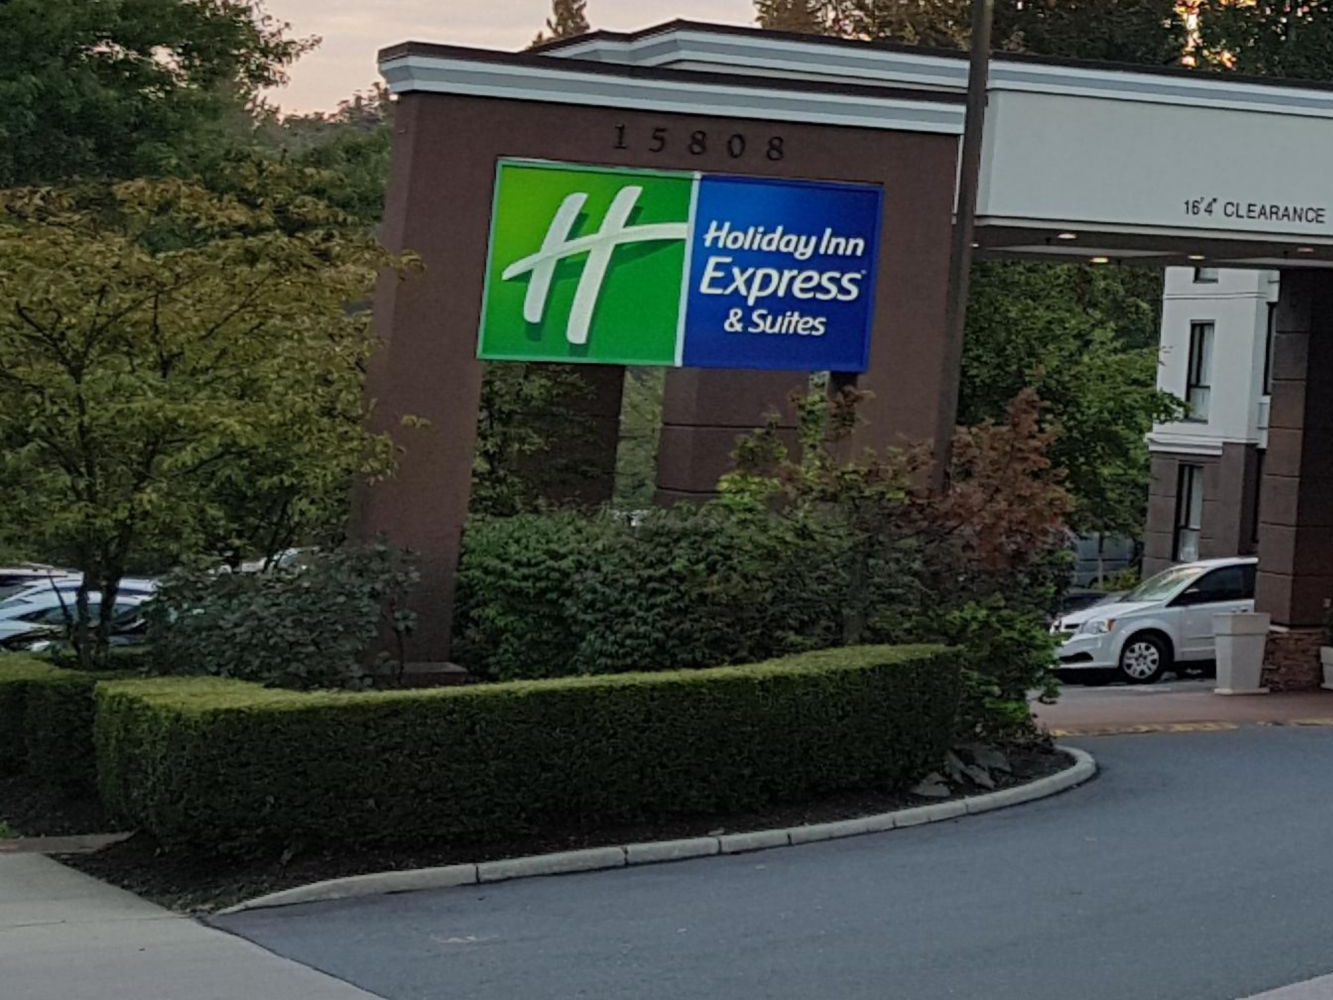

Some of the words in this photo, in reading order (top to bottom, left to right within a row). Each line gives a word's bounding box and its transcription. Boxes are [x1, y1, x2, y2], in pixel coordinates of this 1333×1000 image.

[613, 123, 784, 161] 15808
[1223, 201, 1326, 223] CLEARANCE
[703, 220, 817, 260] Holiday
[818, 227, 865, 257] Inn
[699, 255, 863, 307] Express
[723, 307, 744, 333] &
[748, 308, 827, 337] Suites
